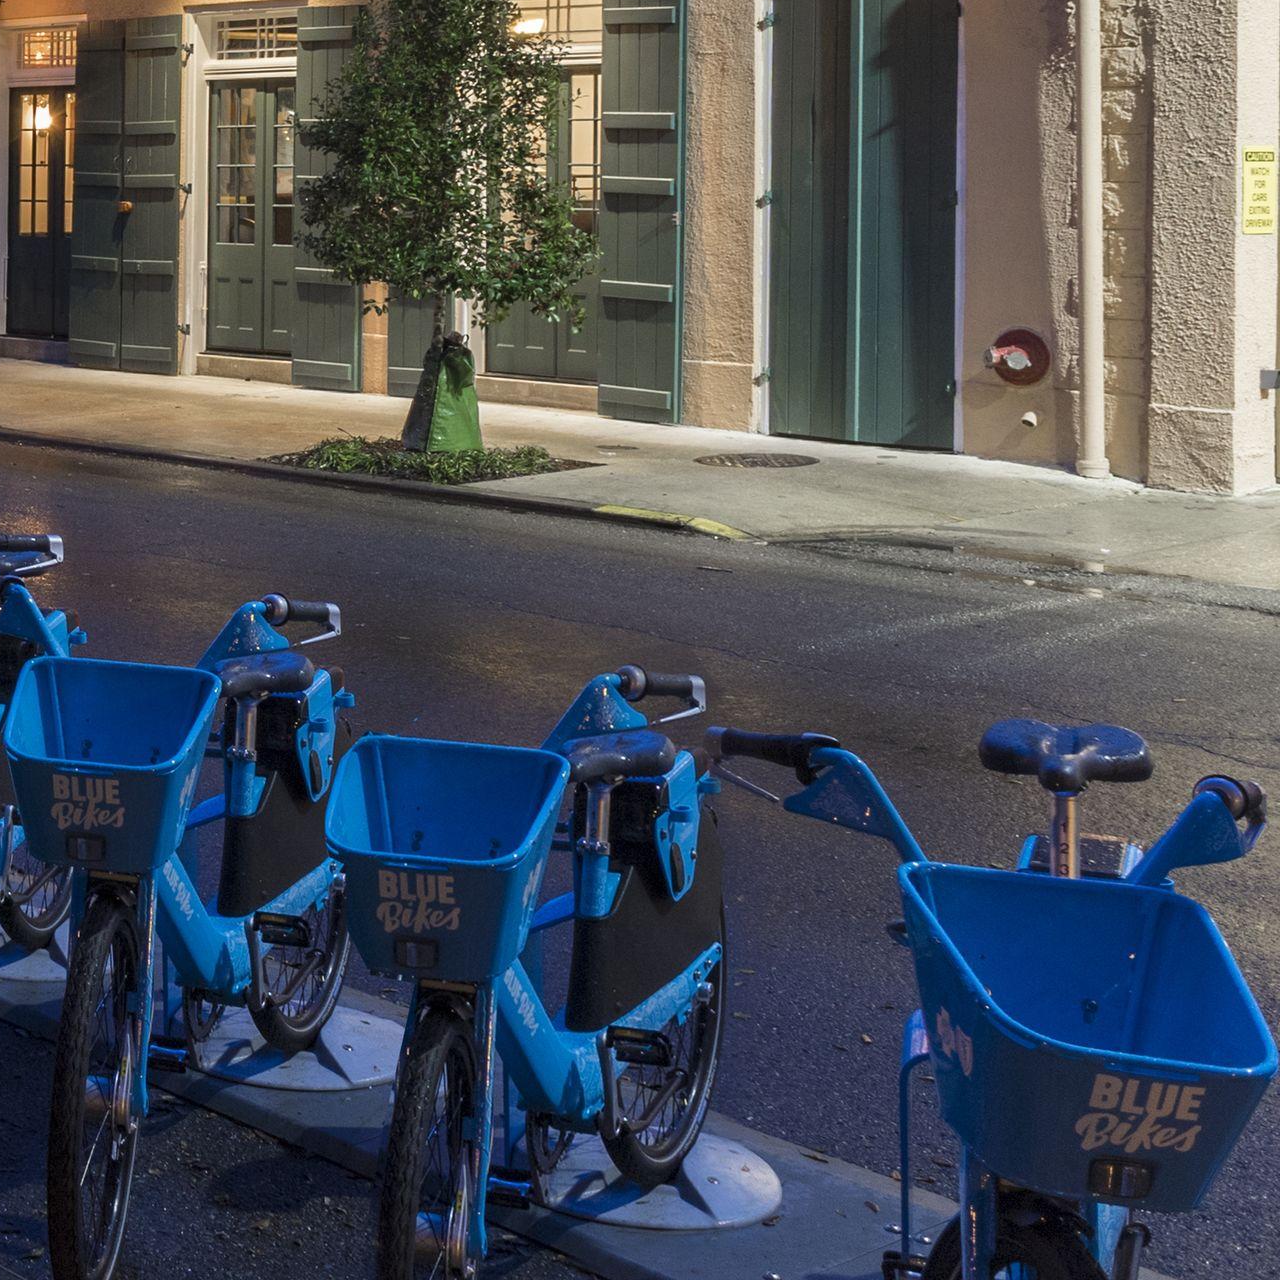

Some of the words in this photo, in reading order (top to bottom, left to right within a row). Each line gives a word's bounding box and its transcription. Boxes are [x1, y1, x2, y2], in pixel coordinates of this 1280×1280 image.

[1247, 152, 1273, 161] CAUTION
[1251, 167, 1269, 175] WATCH
[1254, 180, 1265, 188] FOR
[1252, 193, 1267, 201] CARS
[1249, 206, 1270, 214] EXITING
[1245, 219, 1272, 227] DRIVEWAY
[53, 774, 120, 804] BLUE
[51, 801, 125, 830] Bikes
[1060, 842, 1070, 854] 2
[163, 860, 179, 893] BLUE
[1059, 864, 1070, 875] 3
[378, 870, 455, 904] BLUE
[376, 898, 461, 934] Bikes
[504, 967, 522, 1005] BLUE
[1088, 1074, 1205, 1121] BLUE
[1074, 1112, 1202, 1153] Bikes
